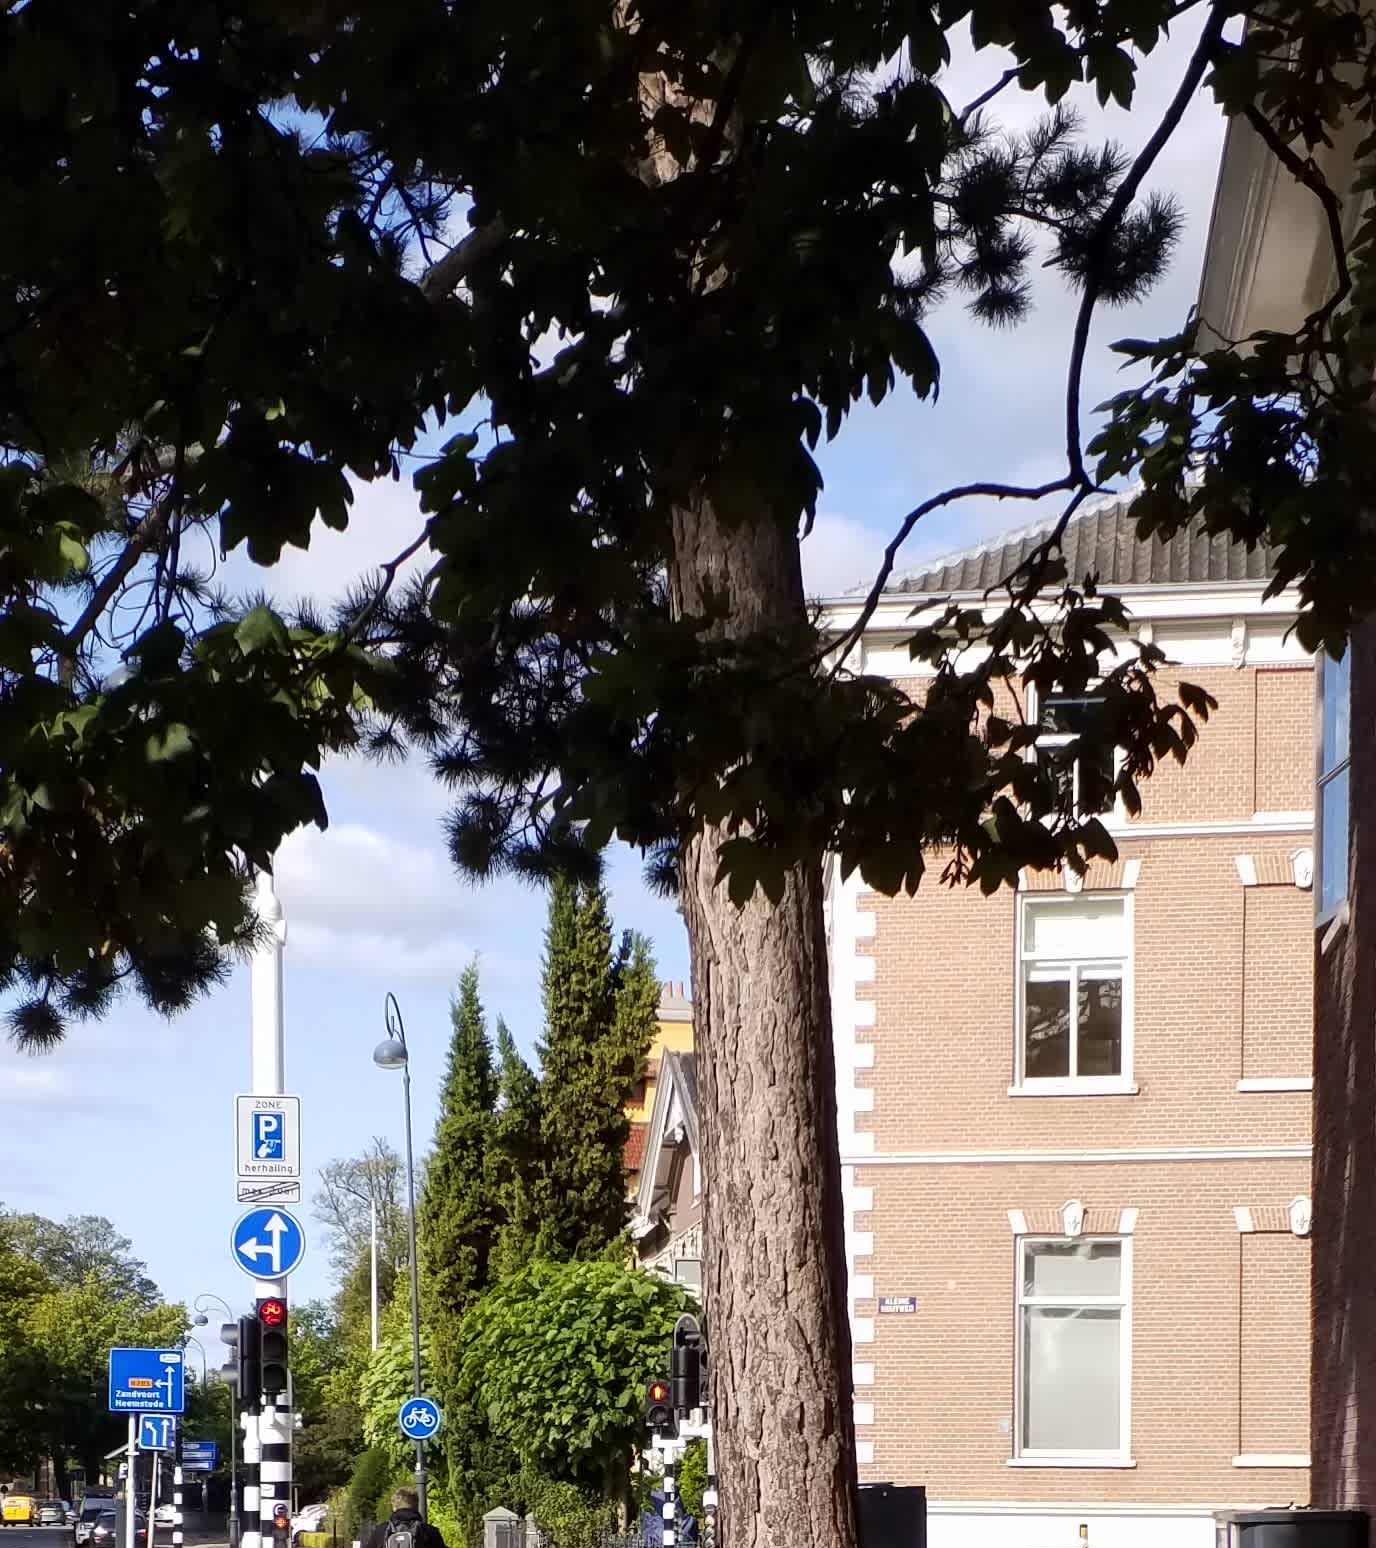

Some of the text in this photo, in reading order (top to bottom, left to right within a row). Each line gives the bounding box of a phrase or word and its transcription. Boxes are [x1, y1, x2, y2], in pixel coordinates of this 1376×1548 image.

[256, 1100, 282, 1109] ZONE
[259, 1116, 278, 1140] P
[245, 1164, 293, 1174] herhaling
[115, 1389, 160, 1399] Zandvoort
